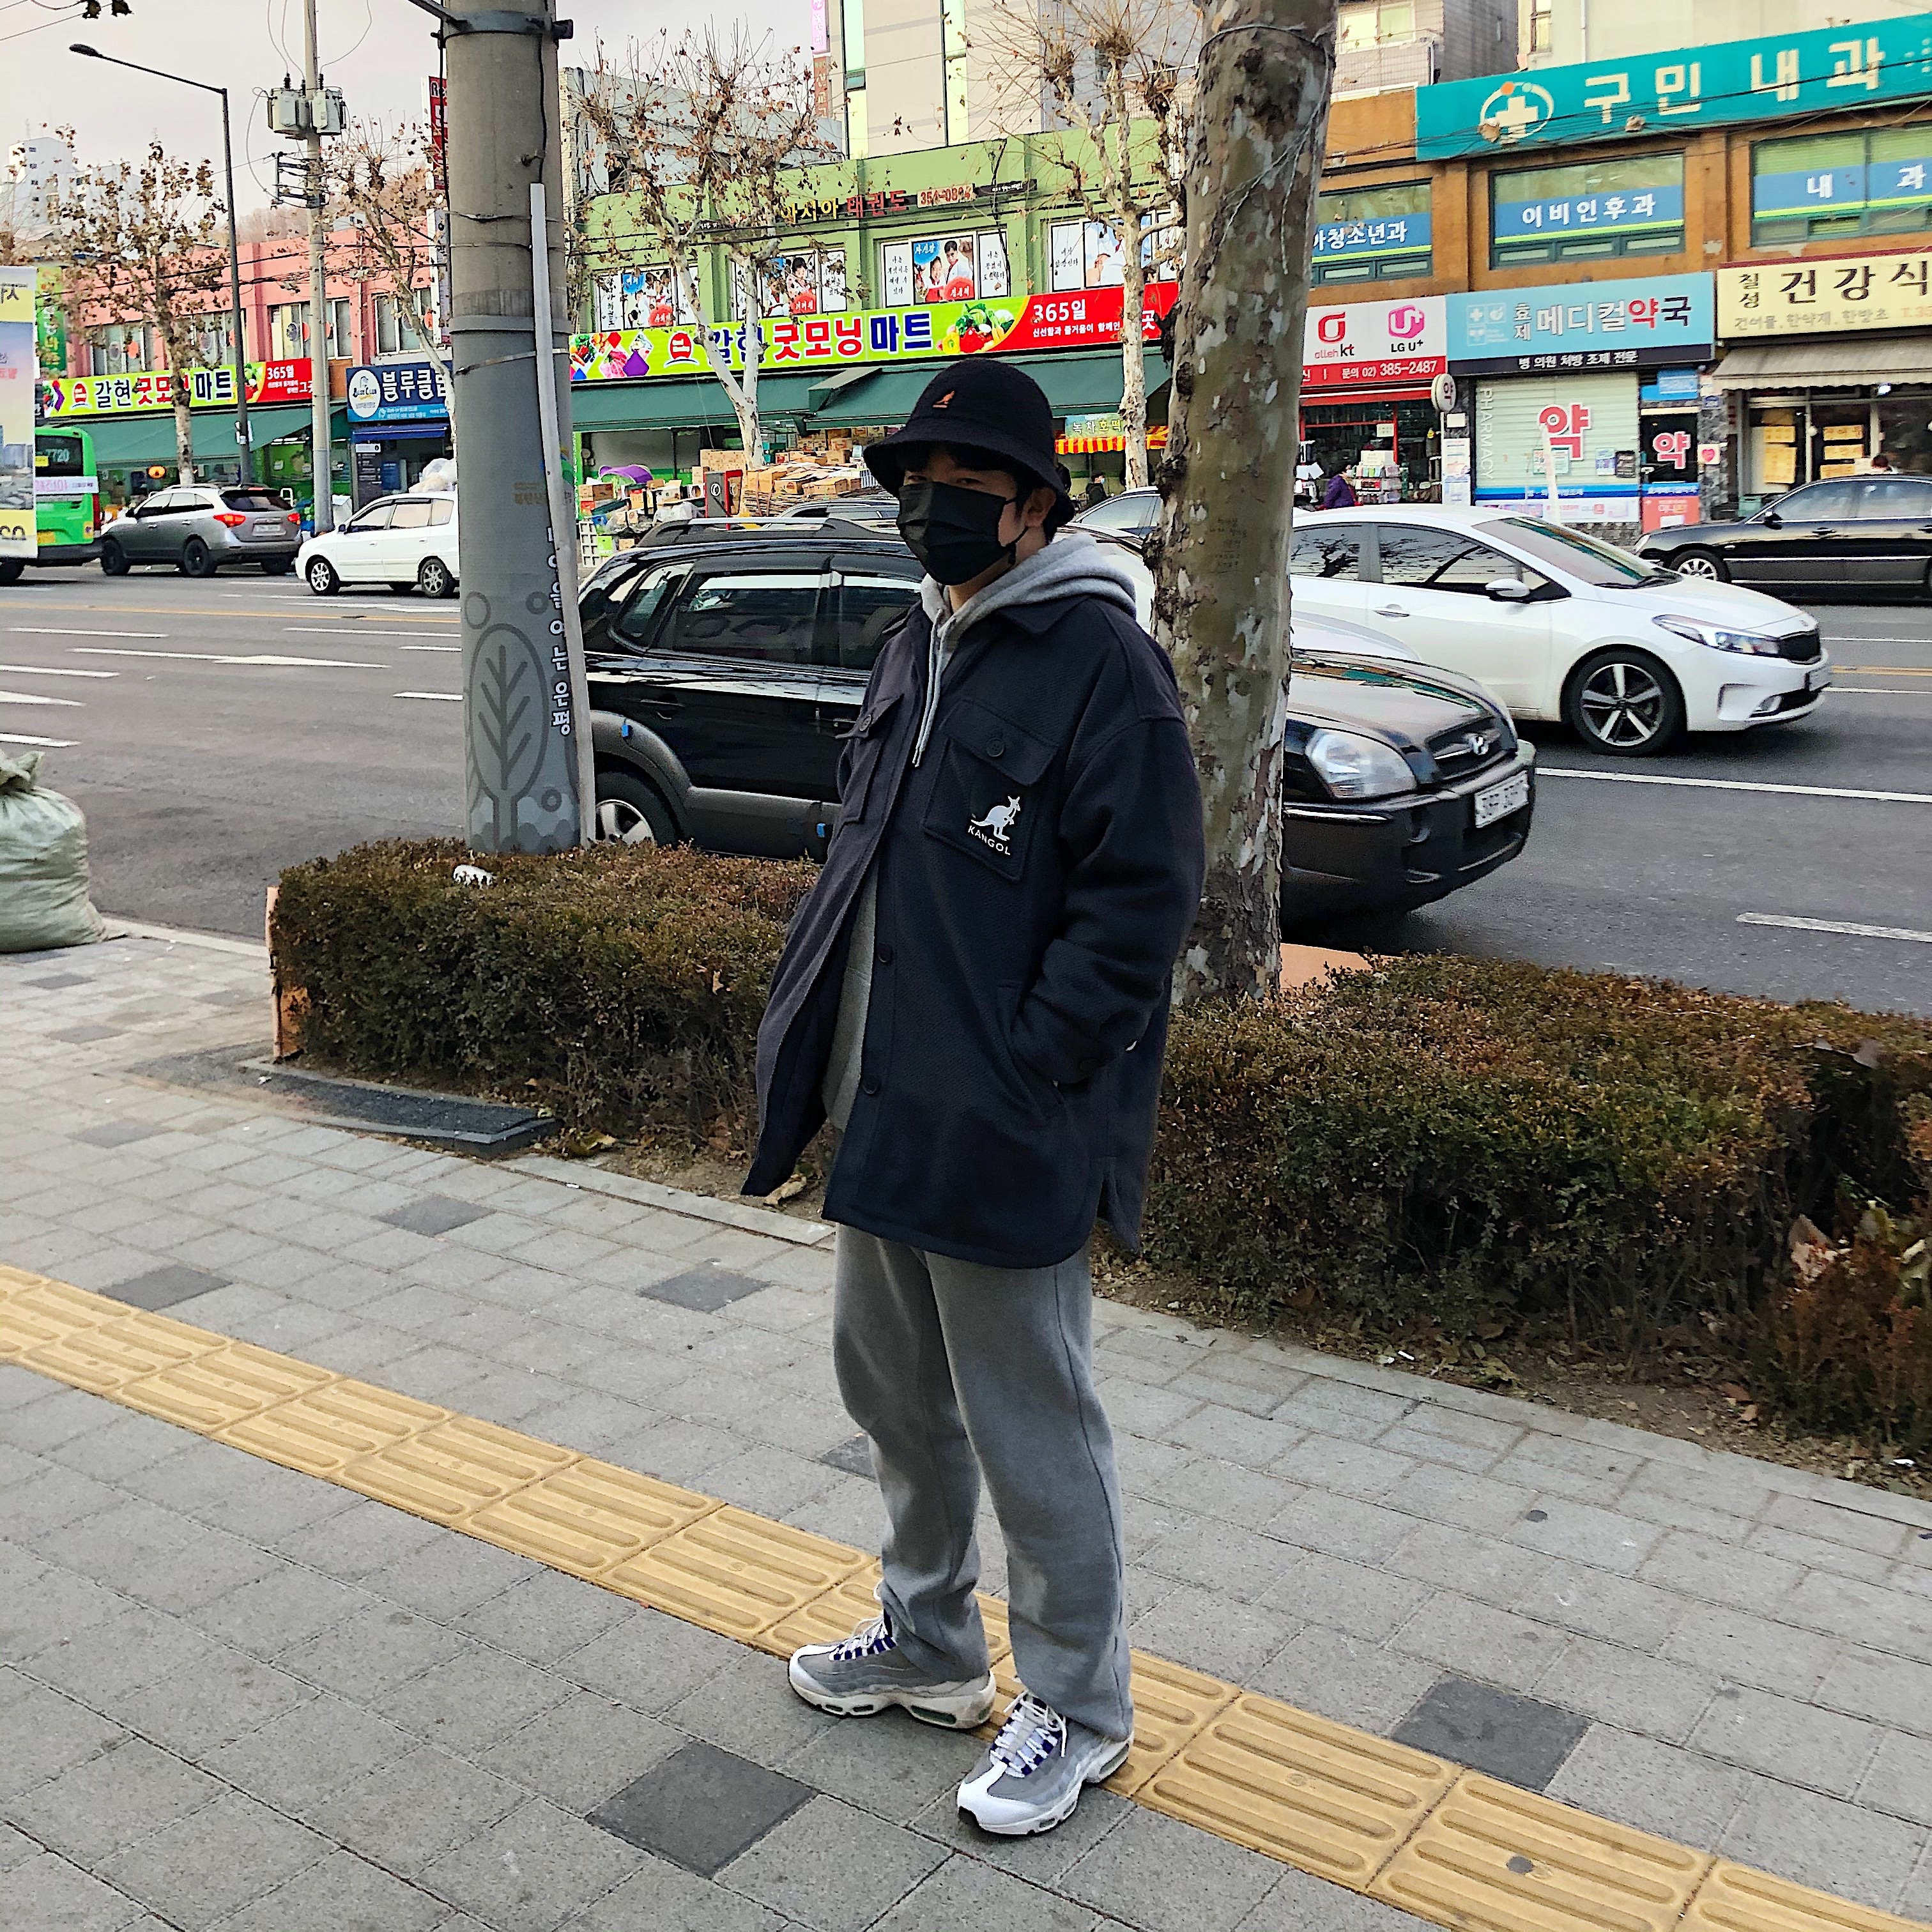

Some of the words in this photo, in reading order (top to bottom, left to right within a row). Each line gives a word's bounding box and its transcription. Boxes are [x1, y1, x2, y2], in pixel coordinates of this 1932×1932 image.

[1584, 62, 1701, 124] 구민
[1751, 37, 1886, 102] 내과
[847, 190, 910, 218] 태권도
[1522, 193, 1656, 228] 이비인후과
[1738, 272, 1759, 309] 칠성
[1033, 299, 1085, 322] 365일
[1514, 303, 1532, 341] 효제
[1391, 342, 1406, 353] LG
[1408, 339, 1424, 351] U+
[1533, 355, 1557, 369] 의원
[1560, 353, 1584, 367] 처방
[1586, 351, 1611, 365] 조제
[1614, 350, 1639, 364] 전문
[1342, 367, 1359, 380] 문의
[1361, 367, 1377, 378] 02)
[1379, 360, 1438, 377] 385-2487
[1480, 388, 1494, 479] PHARMACY
[1538, 402, 1590, 460] 약
[1652, 431, 1692, 470] 약
[968, 825, 1011, 855] KANGOL
